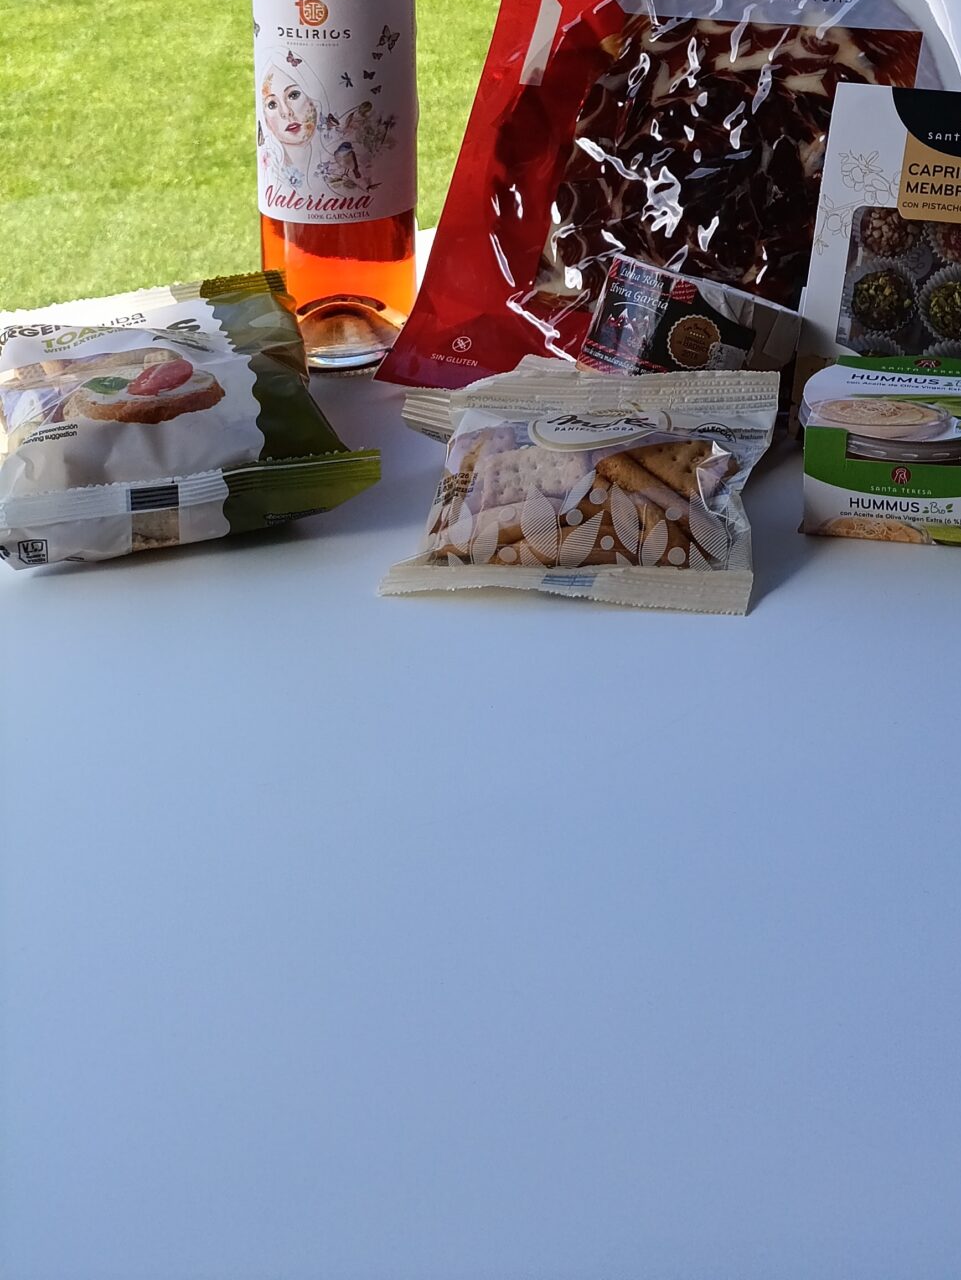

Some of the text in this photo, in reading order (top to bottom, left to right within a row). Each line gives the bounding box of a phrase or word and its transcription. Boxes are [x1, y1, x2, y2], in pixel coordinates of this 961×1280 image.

[278, 27, 351, 39] DELIRIOS
[265, 185, 373, 211] Valeriana
[902, 201, 919, 210] CON
[326, 211, 370, 220] GARNACHA
[633, 290, 669, 310] García
[430, 353, 479, 367] SIN GLUTEN
[851, 373, 940, 385] HUMMUS
[39, 423, 78, 435] presentación
[45, 431, 78, 440] suggestion
[870, 485, 932, 495] SANTA TERESA
[850, 497, 946, 515] HUMMUS Bio
[885, 513, 902, 521] Oliva
[903, 515, 924, 523] Virgen
[926, 516, 943, 524] Extra
